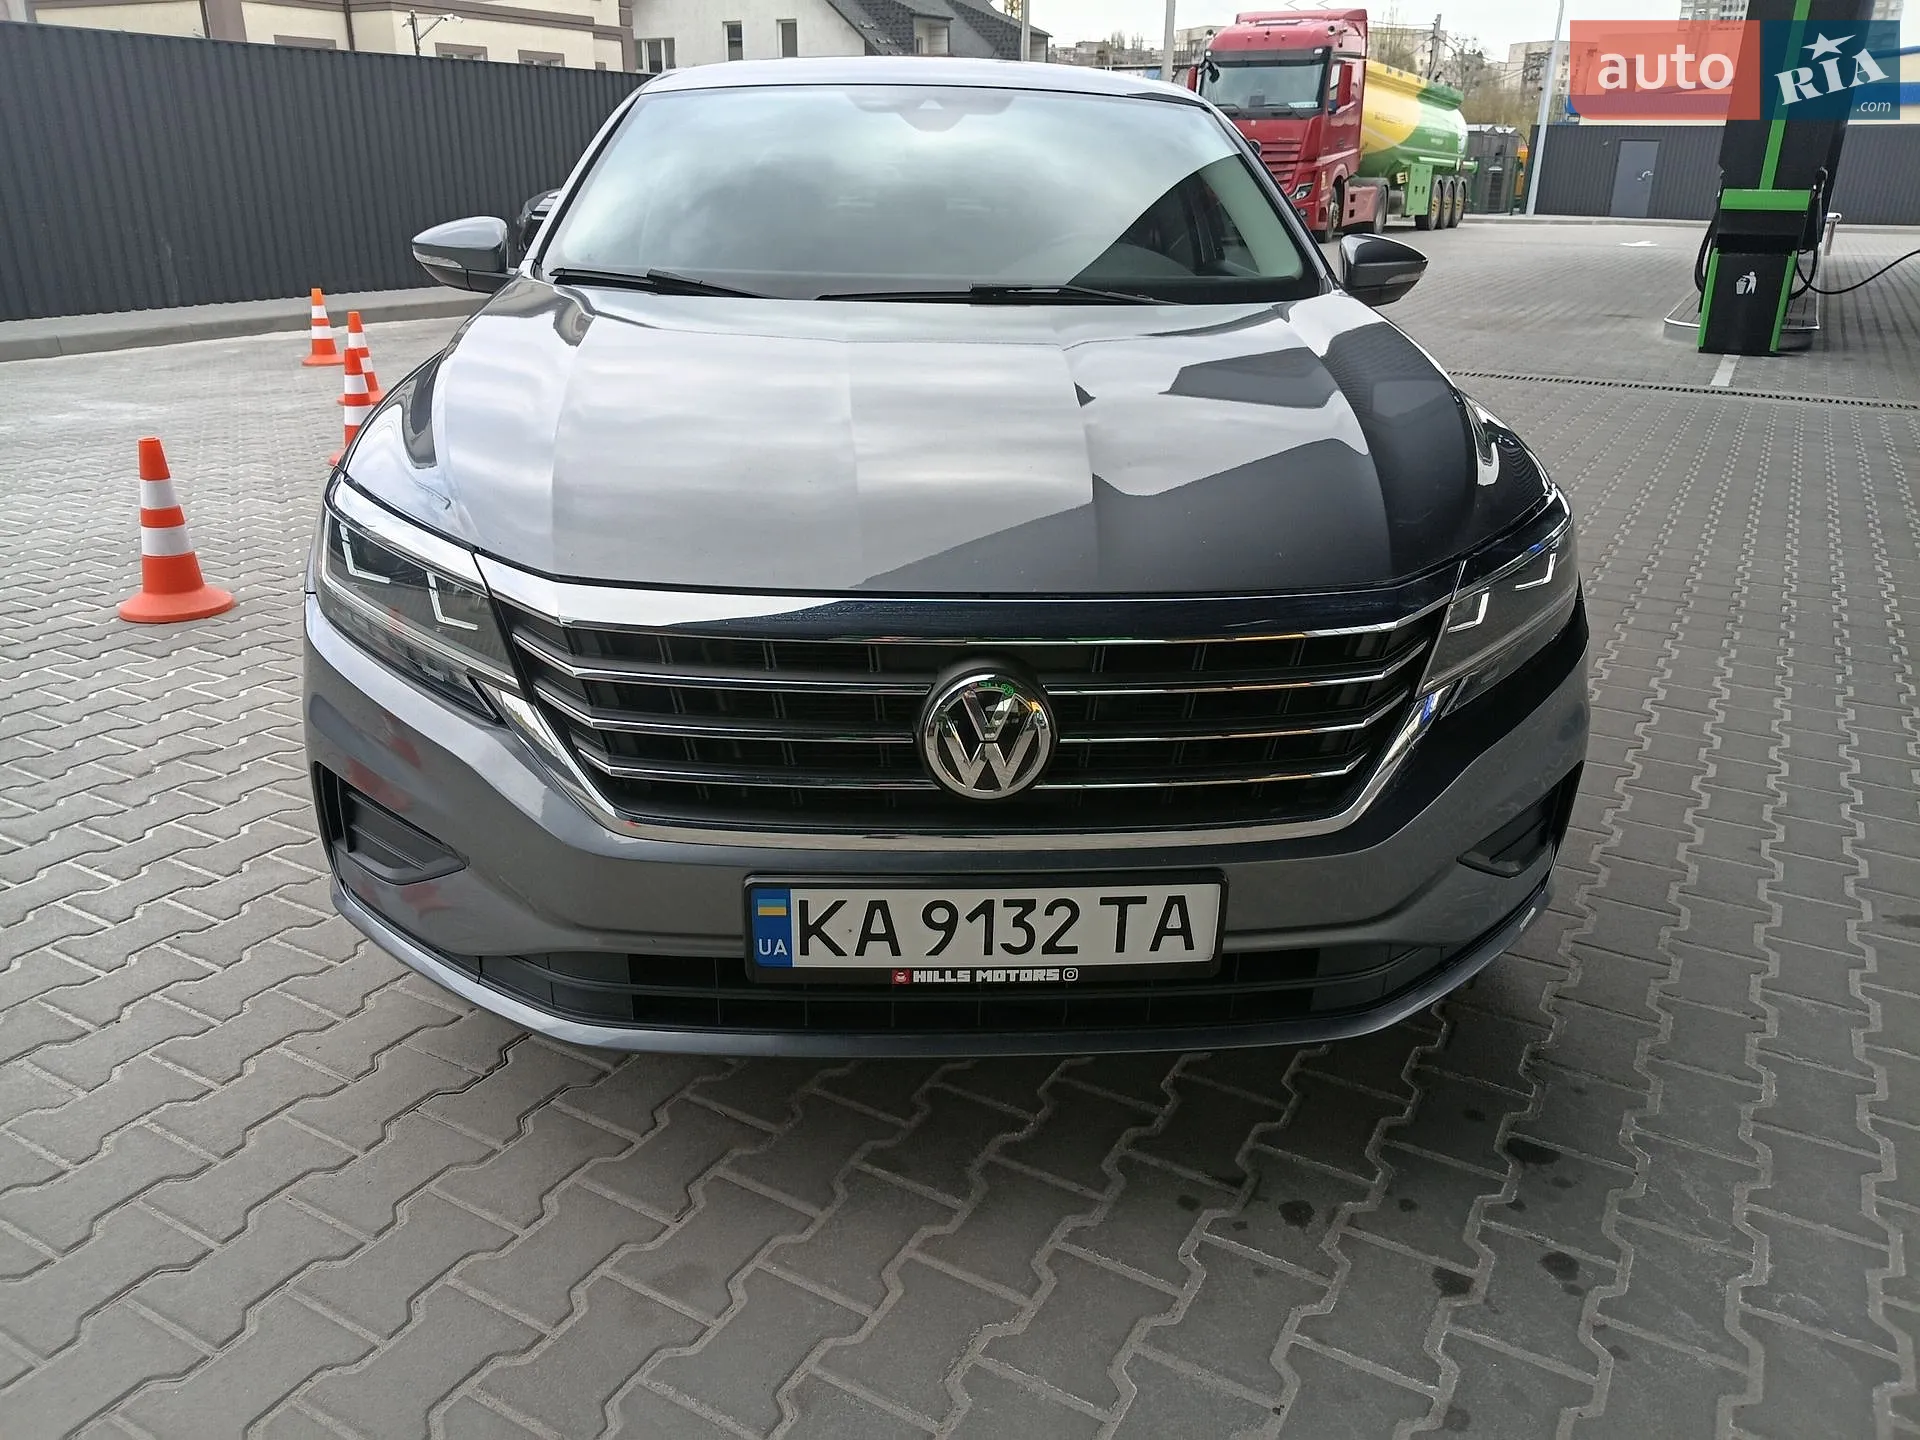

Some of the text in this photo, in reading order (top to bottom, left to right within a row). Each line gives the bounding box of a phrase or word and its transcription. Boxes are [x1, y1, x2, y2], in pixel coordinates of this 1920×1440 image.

[799, 895, 1195, 957] KA 9132 TA
[758, 939, 788, 957] UA
[913, 969, 1060, 983] HILLS MOTORS
